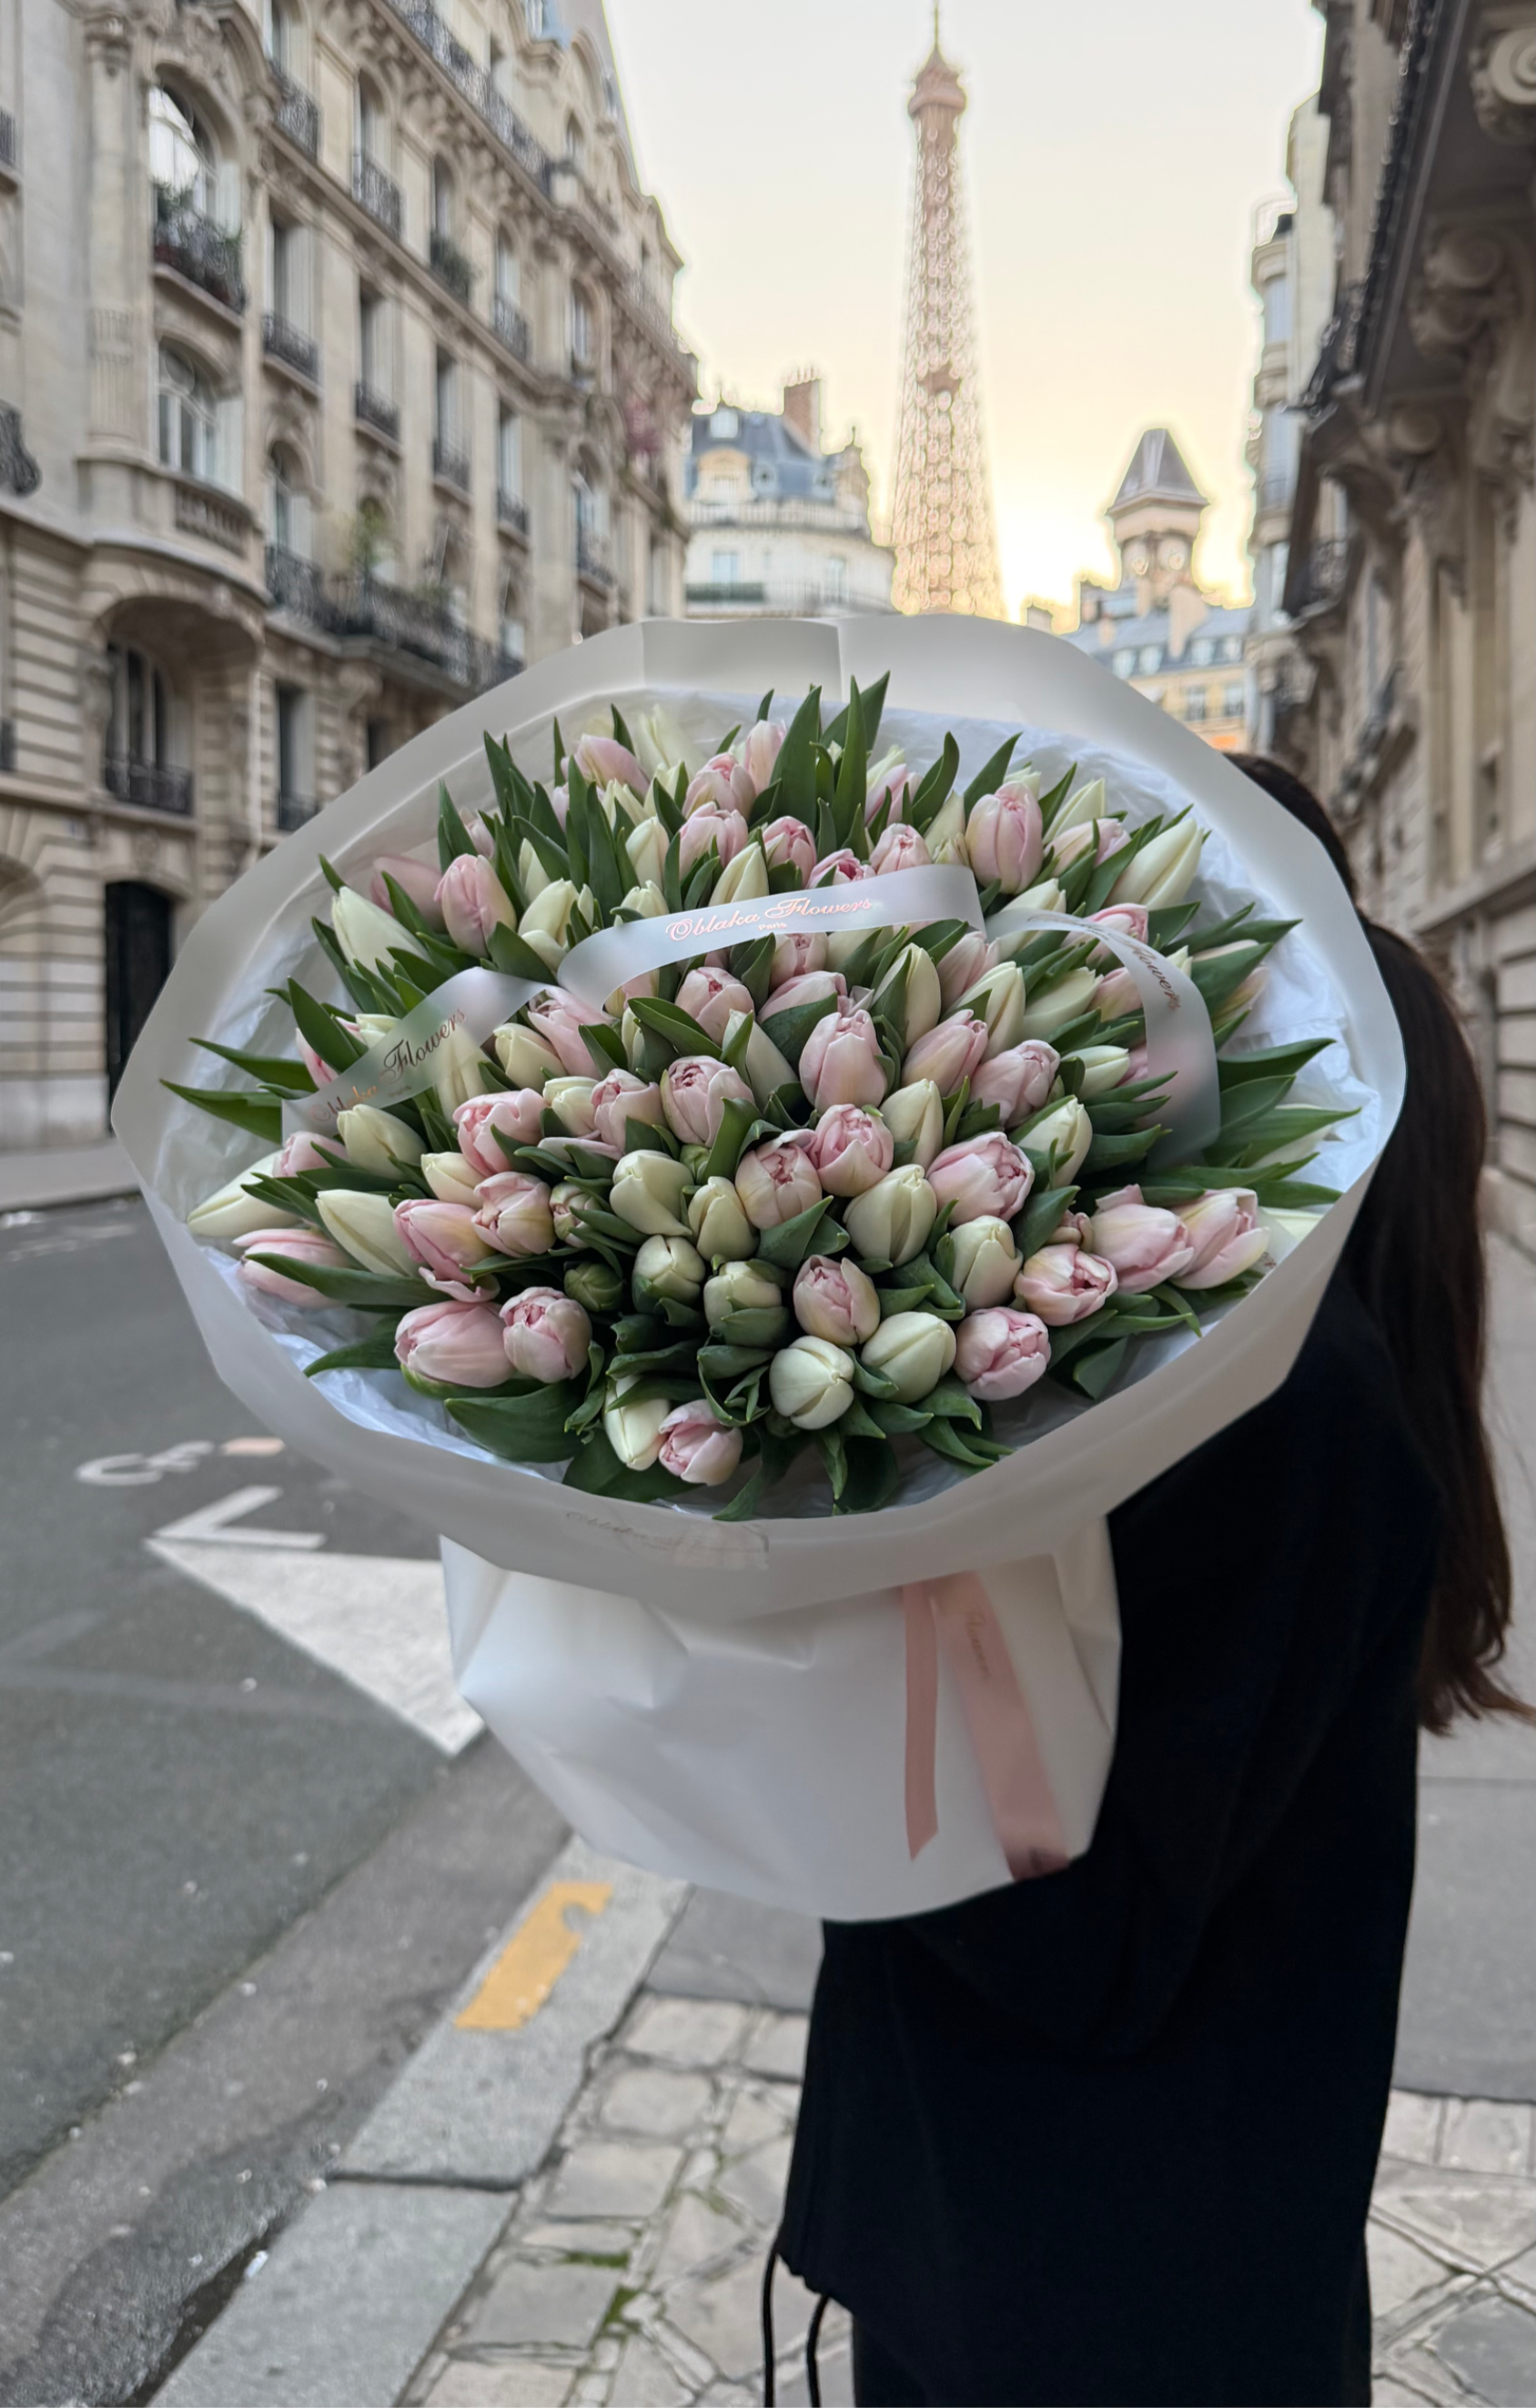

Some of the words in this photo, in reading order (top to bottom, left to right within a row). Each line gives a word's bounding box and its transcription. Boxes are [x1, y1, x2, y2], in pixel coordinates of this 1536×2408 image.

[665, 912, 760, 941] Oblaka
[765, 897, 872, 919] Flowers
[758, 922, 787, 932] Paris
[379, 1008, 466, 1084] Flowers
